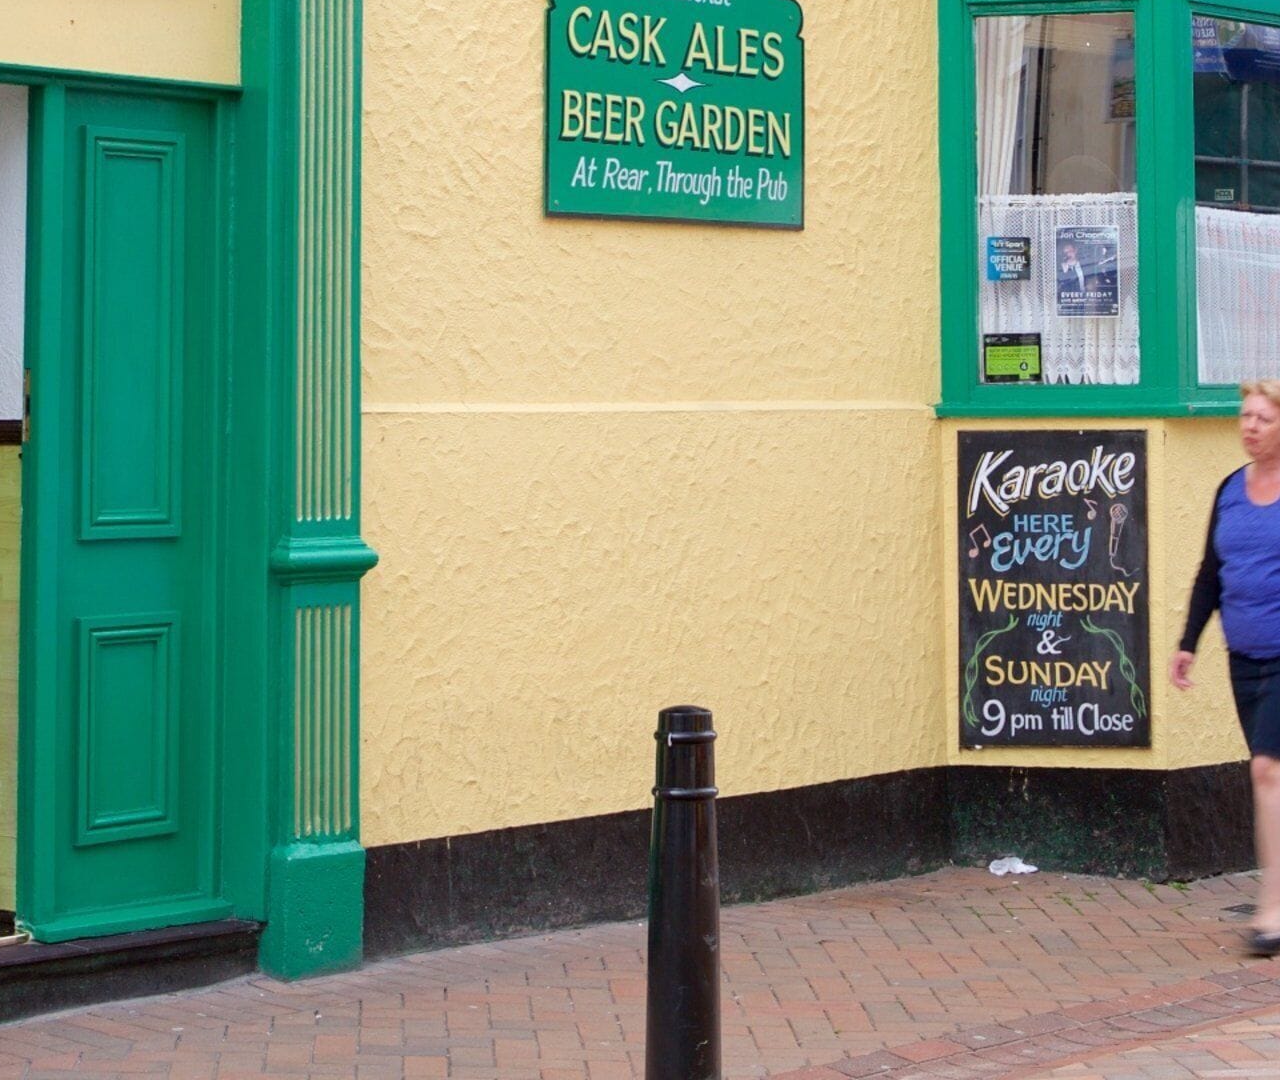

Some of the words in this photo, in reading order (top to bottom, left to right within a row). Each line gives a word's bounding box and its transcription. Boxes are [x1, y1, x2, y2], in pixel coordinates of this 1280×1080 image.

[567, 6, 668, 67] CASK
[683, 22, 786, 78] ALES
[560, 89, 646, 145] BEER
[655, 101, 792, 158] GARDEN
[571, 156, 597, 188] At
[655, 160, 721, 205] Through
[726, 165, 753, 199] the
[756, 167, 788, 201] Pub
[989, 255, 1027, 264] OFFICIAL
[994, 264, 1023, 272] VENUE
[967, 445, 1136, 518] Karaoke
[1013, 514, 1074, 534] HERE
[990, 525, 1093, 572] Every
[968, 578, 1141, 614] WEDNESDAY
[1027, 610, 1064, 632] night
[1036, 630, 1072, 655] &
[985, 655, 1112, 690] SUNDAY
[1030, 685, 1068, 708] night
[981, 699, 1007, 737] 9
[1011, 710, 1043, 738] pm
[1051, 705, 1073, 731] till
[1077, 702, 1134, 736] Close
